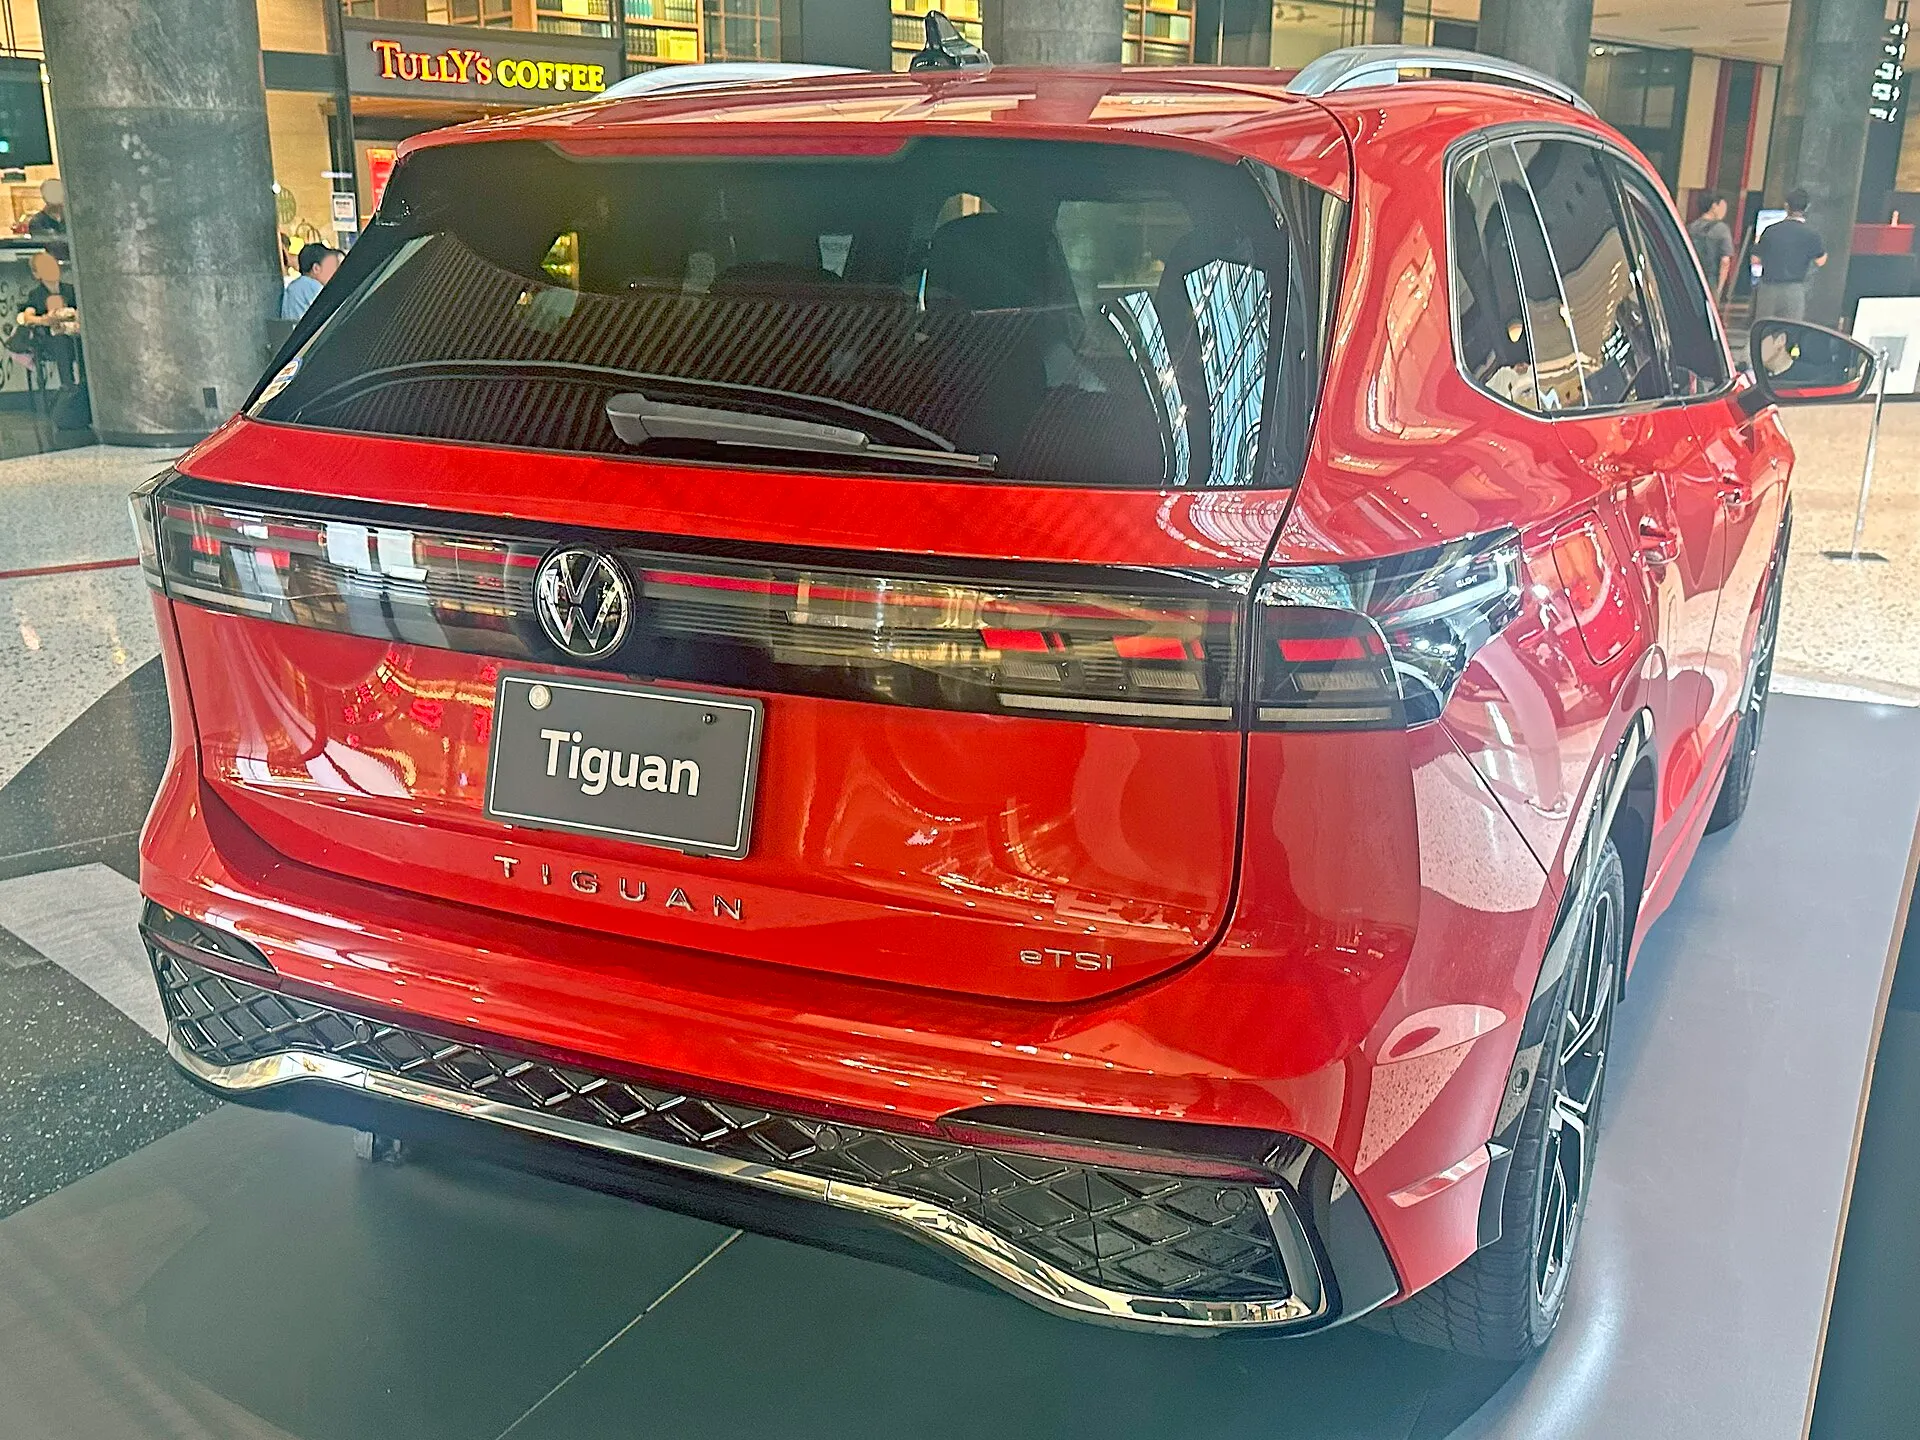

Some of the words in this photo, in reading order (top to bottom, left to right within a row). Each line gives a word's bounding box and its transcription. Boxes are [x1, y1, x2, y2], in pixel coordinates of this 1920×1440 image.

[496, 59, 606, 92] COFFEE
[540, 728, 700, 797] Tiguan
[493, 855, 743, 921] TIGUAN
